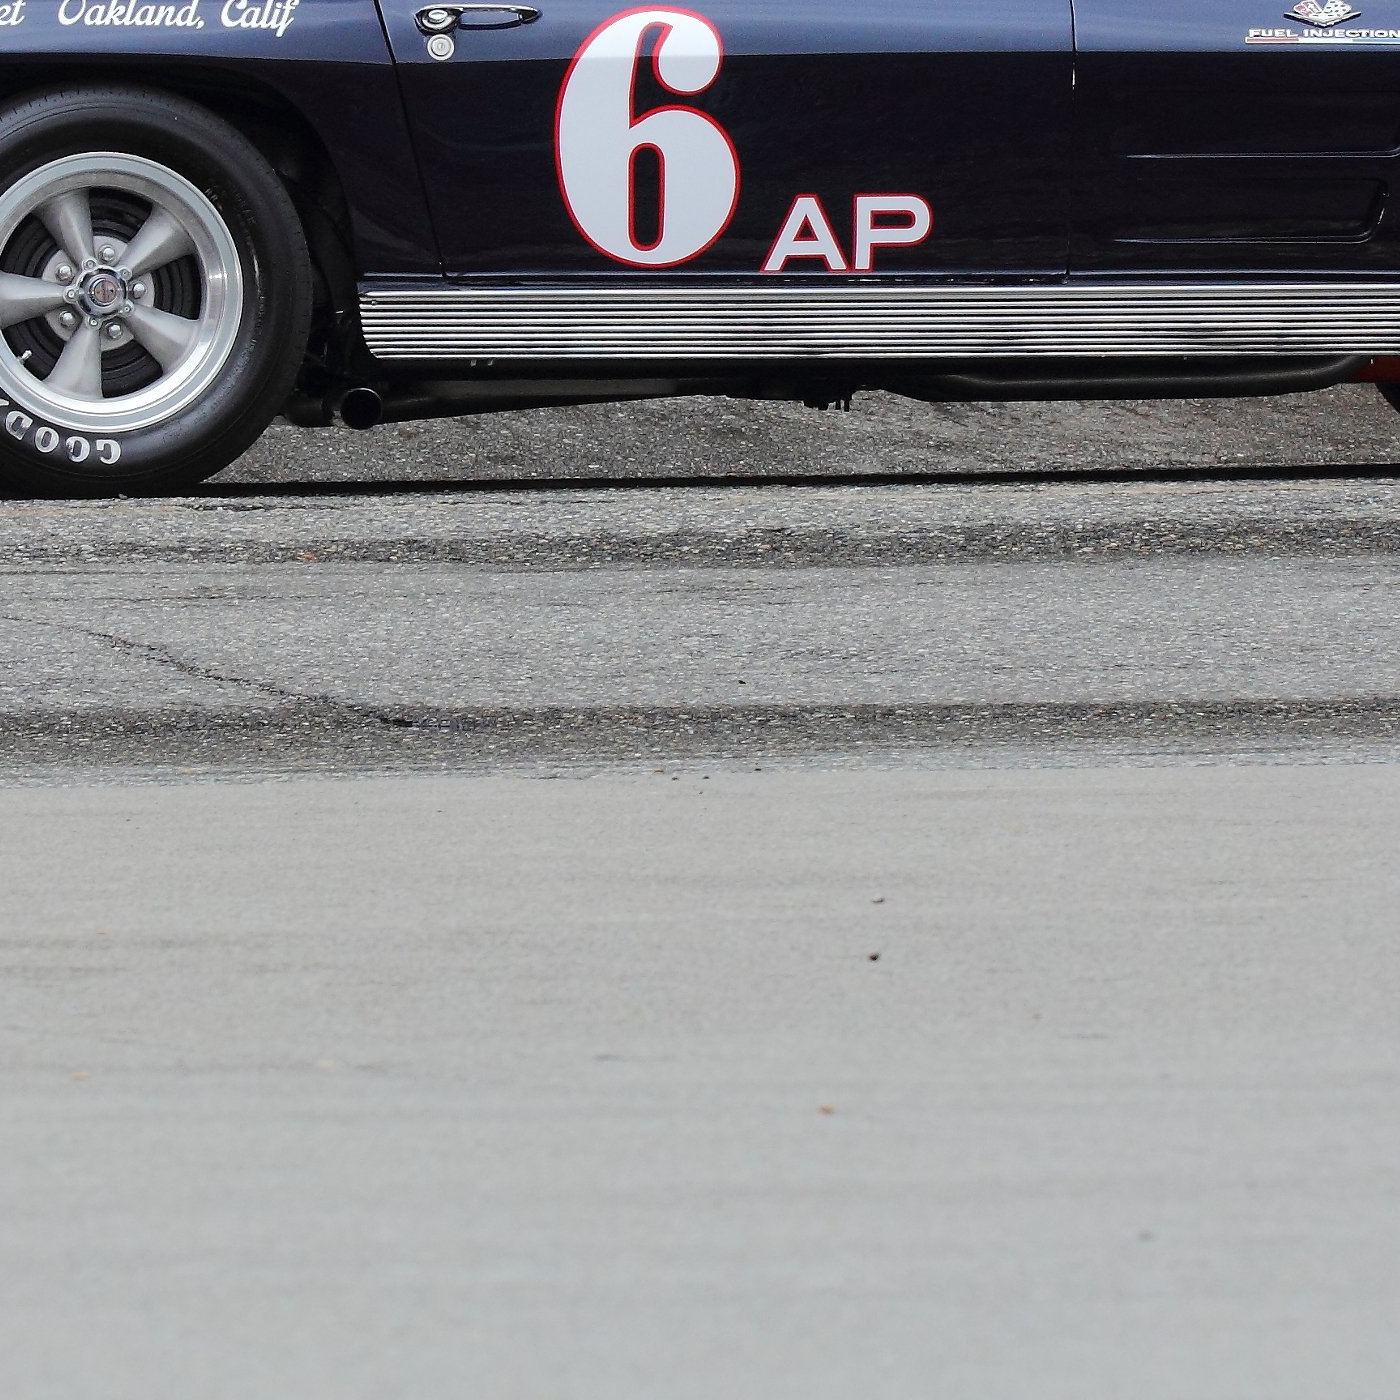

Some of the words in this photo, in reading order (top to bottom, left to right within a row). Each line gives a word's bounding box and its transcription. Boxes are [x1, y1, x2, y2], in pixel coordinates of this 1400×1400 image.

[1249, 28, 1299, 38] FUEL
[553, 4, 742, 269] 6
[760, 193, 934, 272] AP
